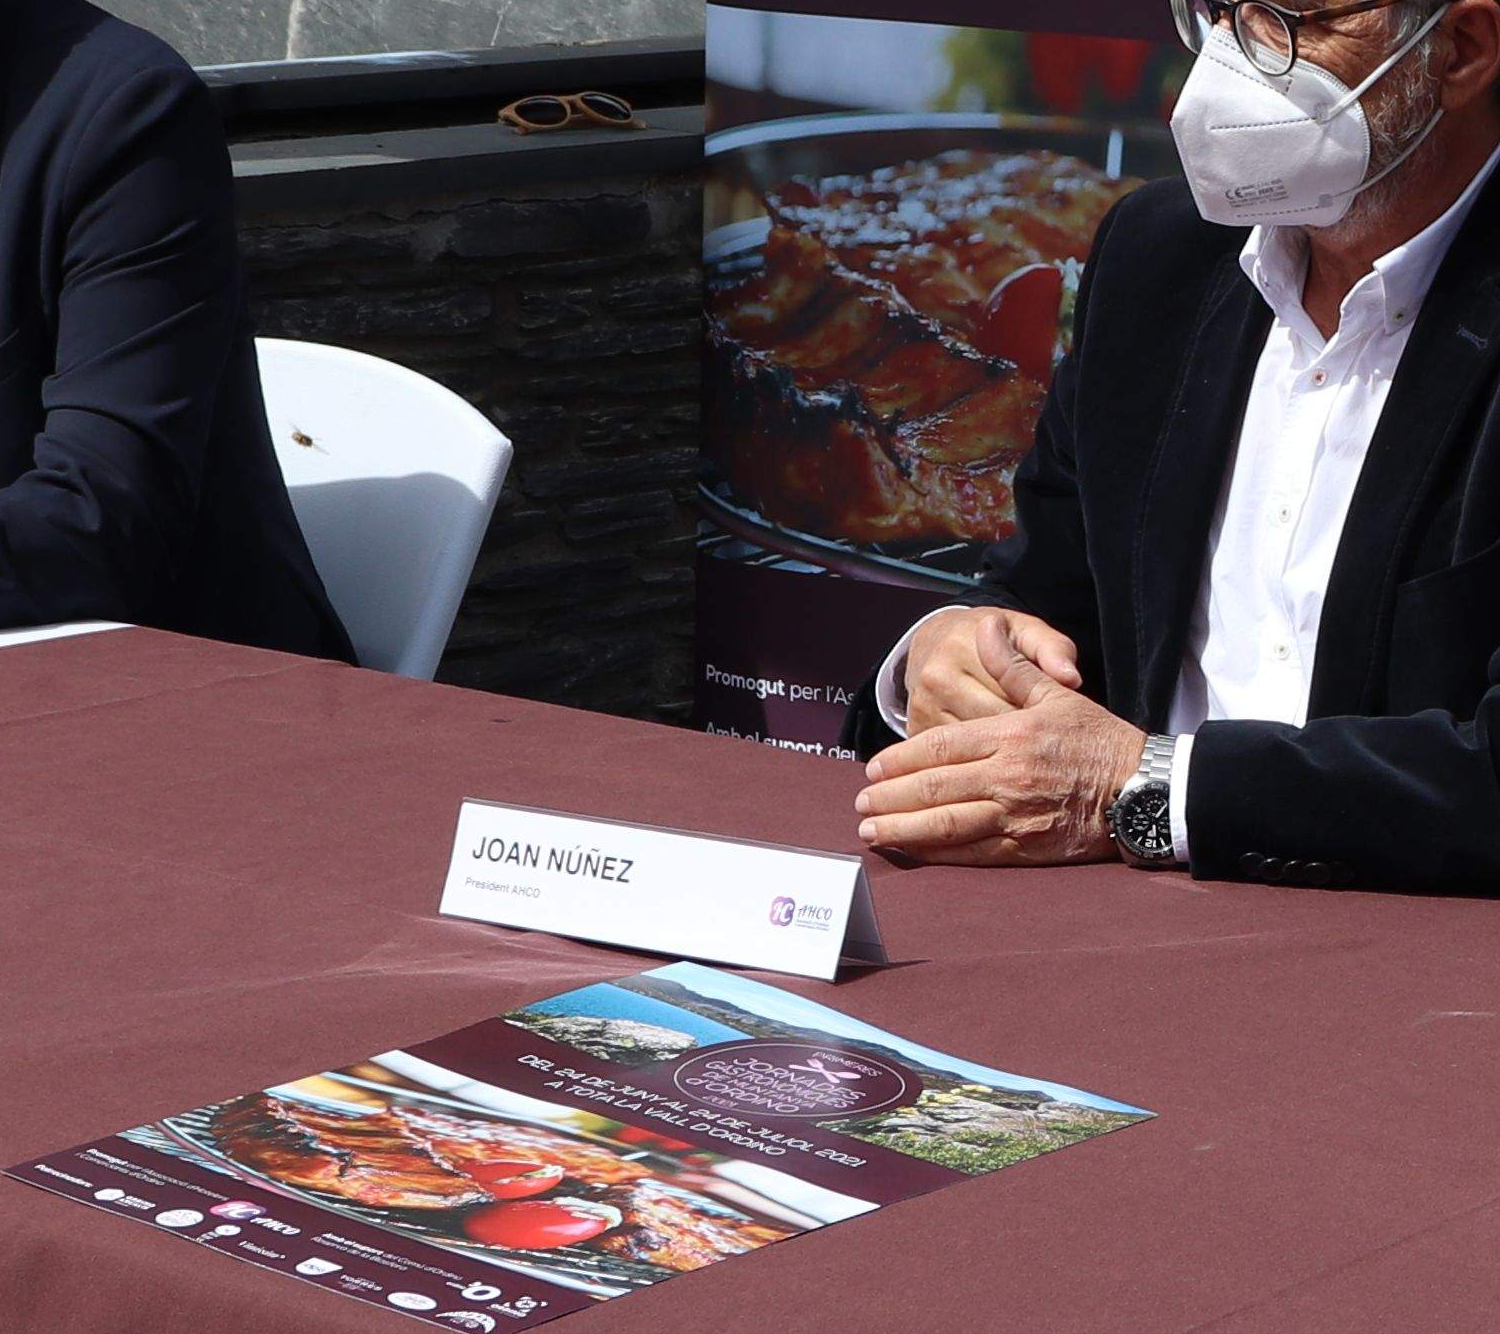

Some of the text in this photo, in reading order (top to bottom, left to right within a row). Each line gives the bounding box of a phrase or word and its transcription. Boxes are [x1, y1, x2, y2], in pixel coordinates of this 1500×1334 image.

[706, 664, 785, 699] Promogut
[790, 684, 822, 702] per
[472, 837, 633, 883] JOAN NÚÑEZ
[465, 876, 541, 898] President AHCO
[798, 905, 833, 921] AHCO
[732, 1058, 867, 1101] JORNADES
[518, 1055, 866, 1168] DEL 24 DE JUNY AL 24 DE JULIOL 2021
[544, 1080, 563, 1090] A
[564, 1085, 615, 1105] TOTA
[613, 1100, 642, 1111] LA
[643, 1107, 694, 1128] VALL
